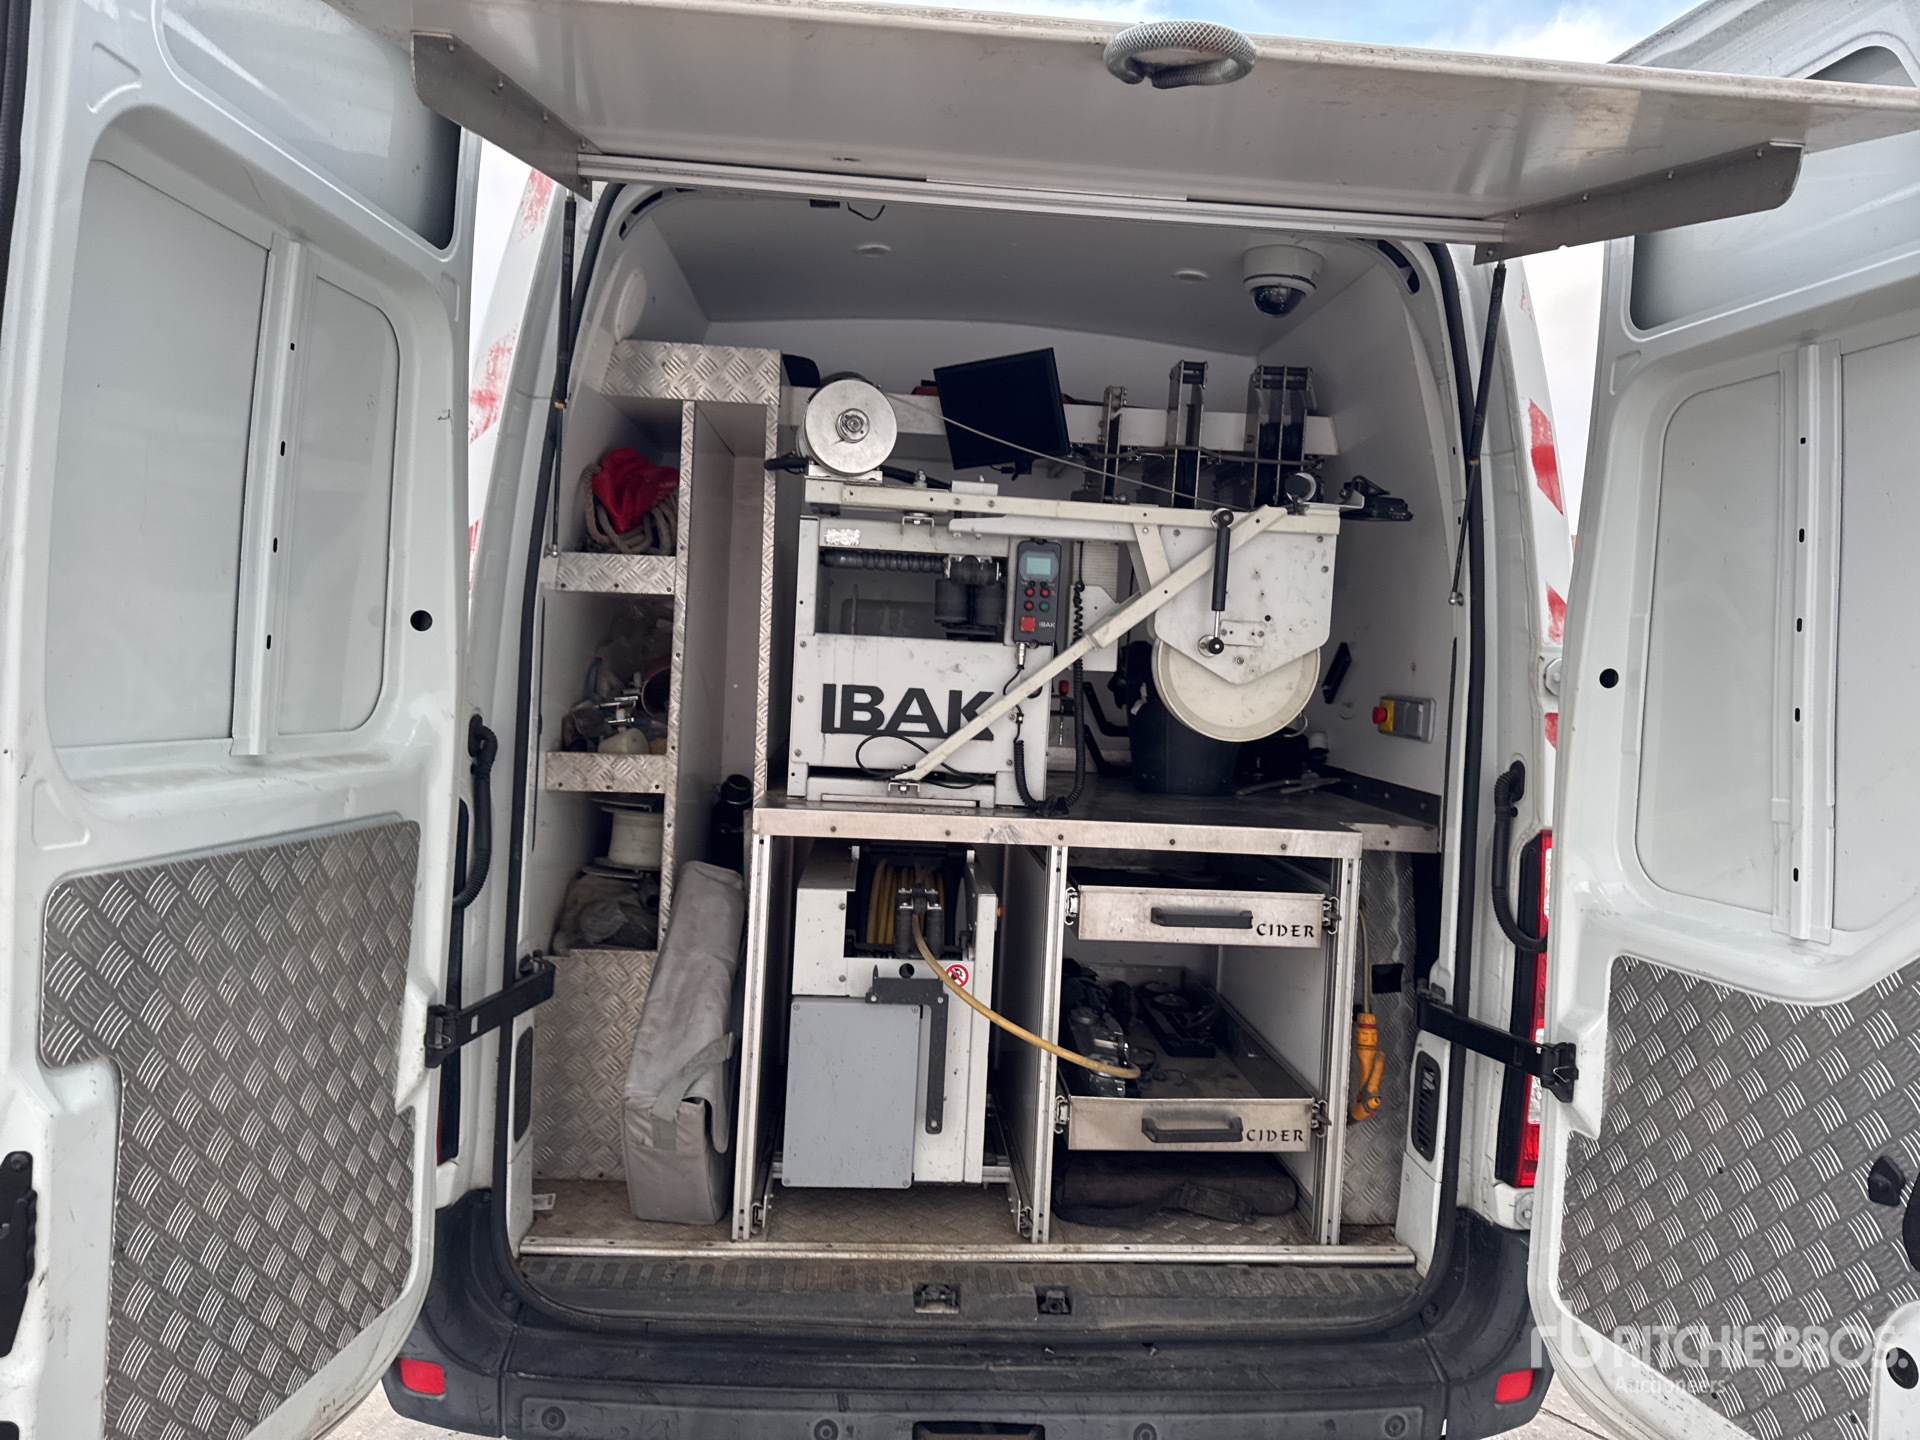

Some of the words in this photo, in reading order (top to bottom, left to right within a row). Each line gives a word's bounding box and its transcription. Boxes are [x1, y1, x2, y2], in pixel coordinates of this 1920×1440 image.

[821, 683, 995, 742] IBAK
[1256, 923, 1315, 938] CIDER
[1246, 1129, 1304, 1142] CIDER
